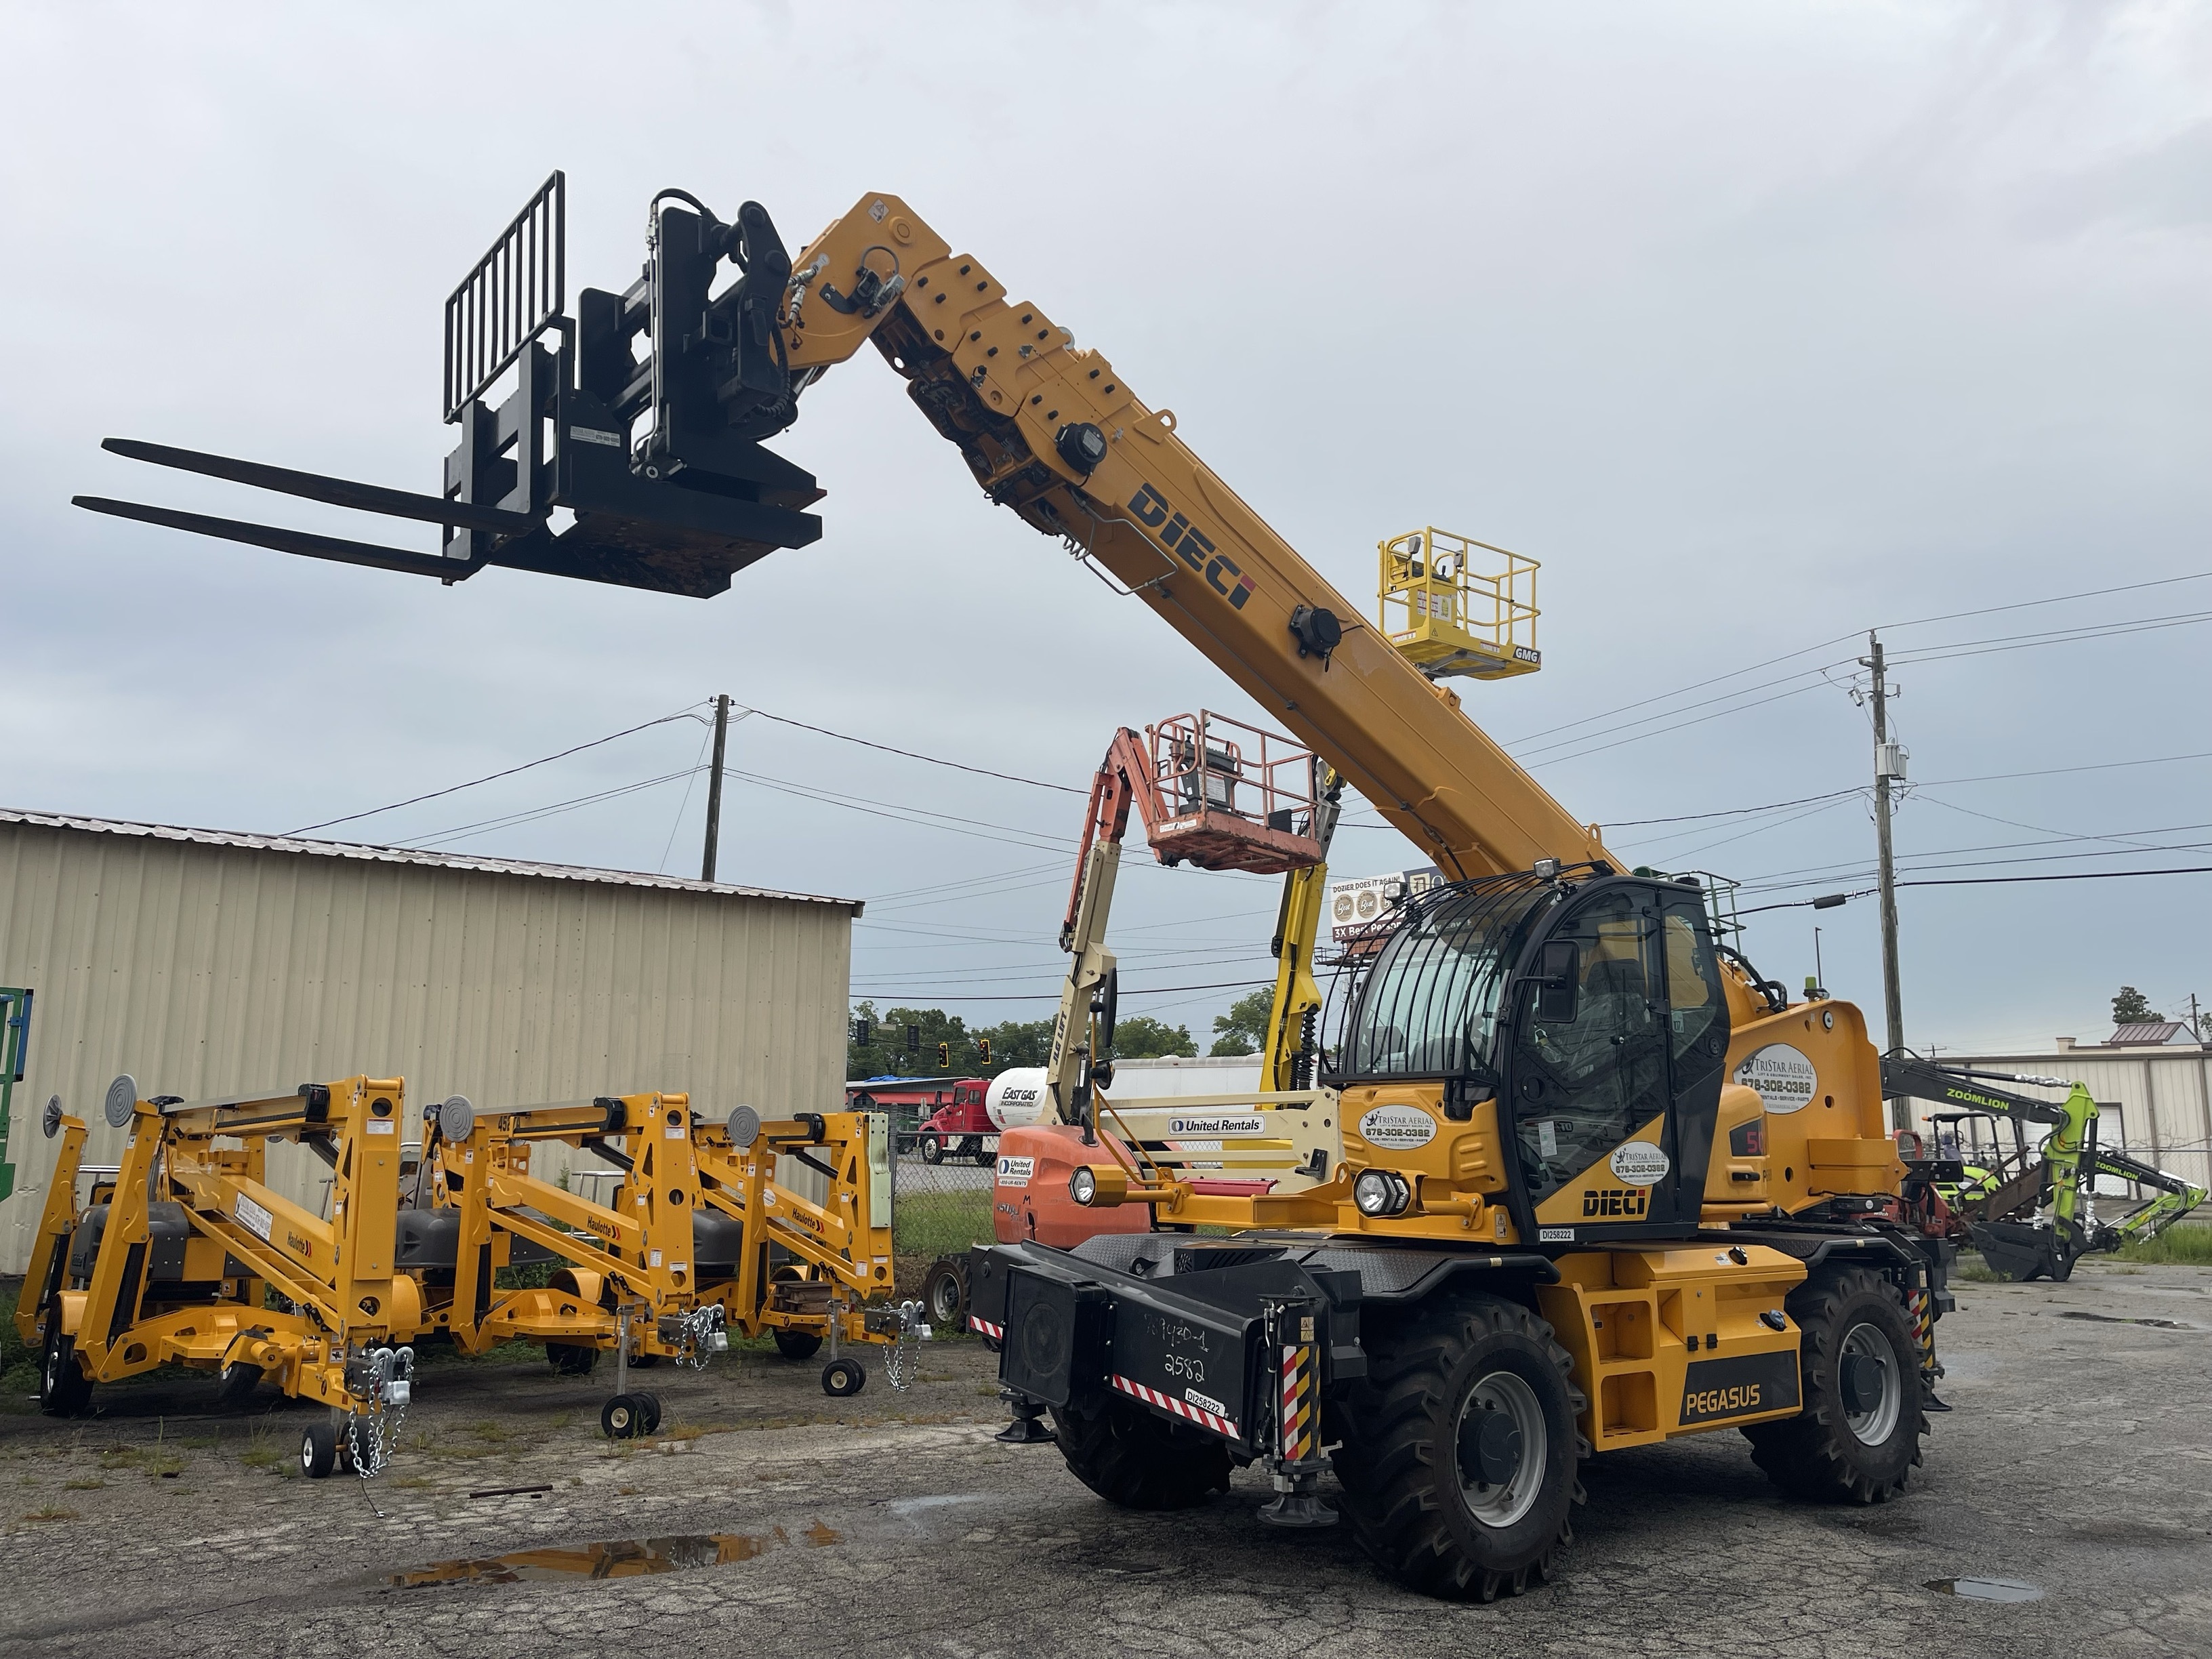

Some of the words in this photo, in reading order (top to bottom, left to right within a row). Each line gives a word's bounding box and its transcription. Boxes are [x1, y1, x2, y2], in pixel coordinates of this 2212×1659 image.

[1515, 648, 1538, 662] GMG
[1333, 884, 1354, 893] DOZIER
[1379, 876, 1400, 885] AGAIN!
[1337, 903, 1351, 916] Best
[1359, 899, 1374, 912] Best
[1334, 927, 1347, 938] 3X
[1057, 1010, 1067, 1040] LIFT
[1788, 1061, 1814, 1075] AERIAL
[1021, 1090, 1038, 1101] GAS
[1946, 1088, 2009, 1111] ZOOMLION
[1186, 1120, 1219, 1131] United
[1221, 1119, 1259, 1130] Rentals
[1408, 1117, 1433, 1125] AERIAL
[1366, 1128, 1430, 1137] 678-302-0382
[1010, 1160, 1031, 1168] United
[2095, 1161, 2139, 1181] ZOOMLION
[1010, 1168, 1031, 1176] Rentals
[1023, 1195, 1031, 1205] M
[792, 1207, 816, 1229] Haulotte
[587, 1215, 611, 1237] Haulotte
[287, 1231, 305, 1254] Haulotte
[1542, 1231, 1572, 1240] DI258222
[1164, 1354, 1205, 1382] 2582
[1187, 1391, 1220, 1414] DI258222
[1686, 1384, 1761, 1416] PEGASUS
